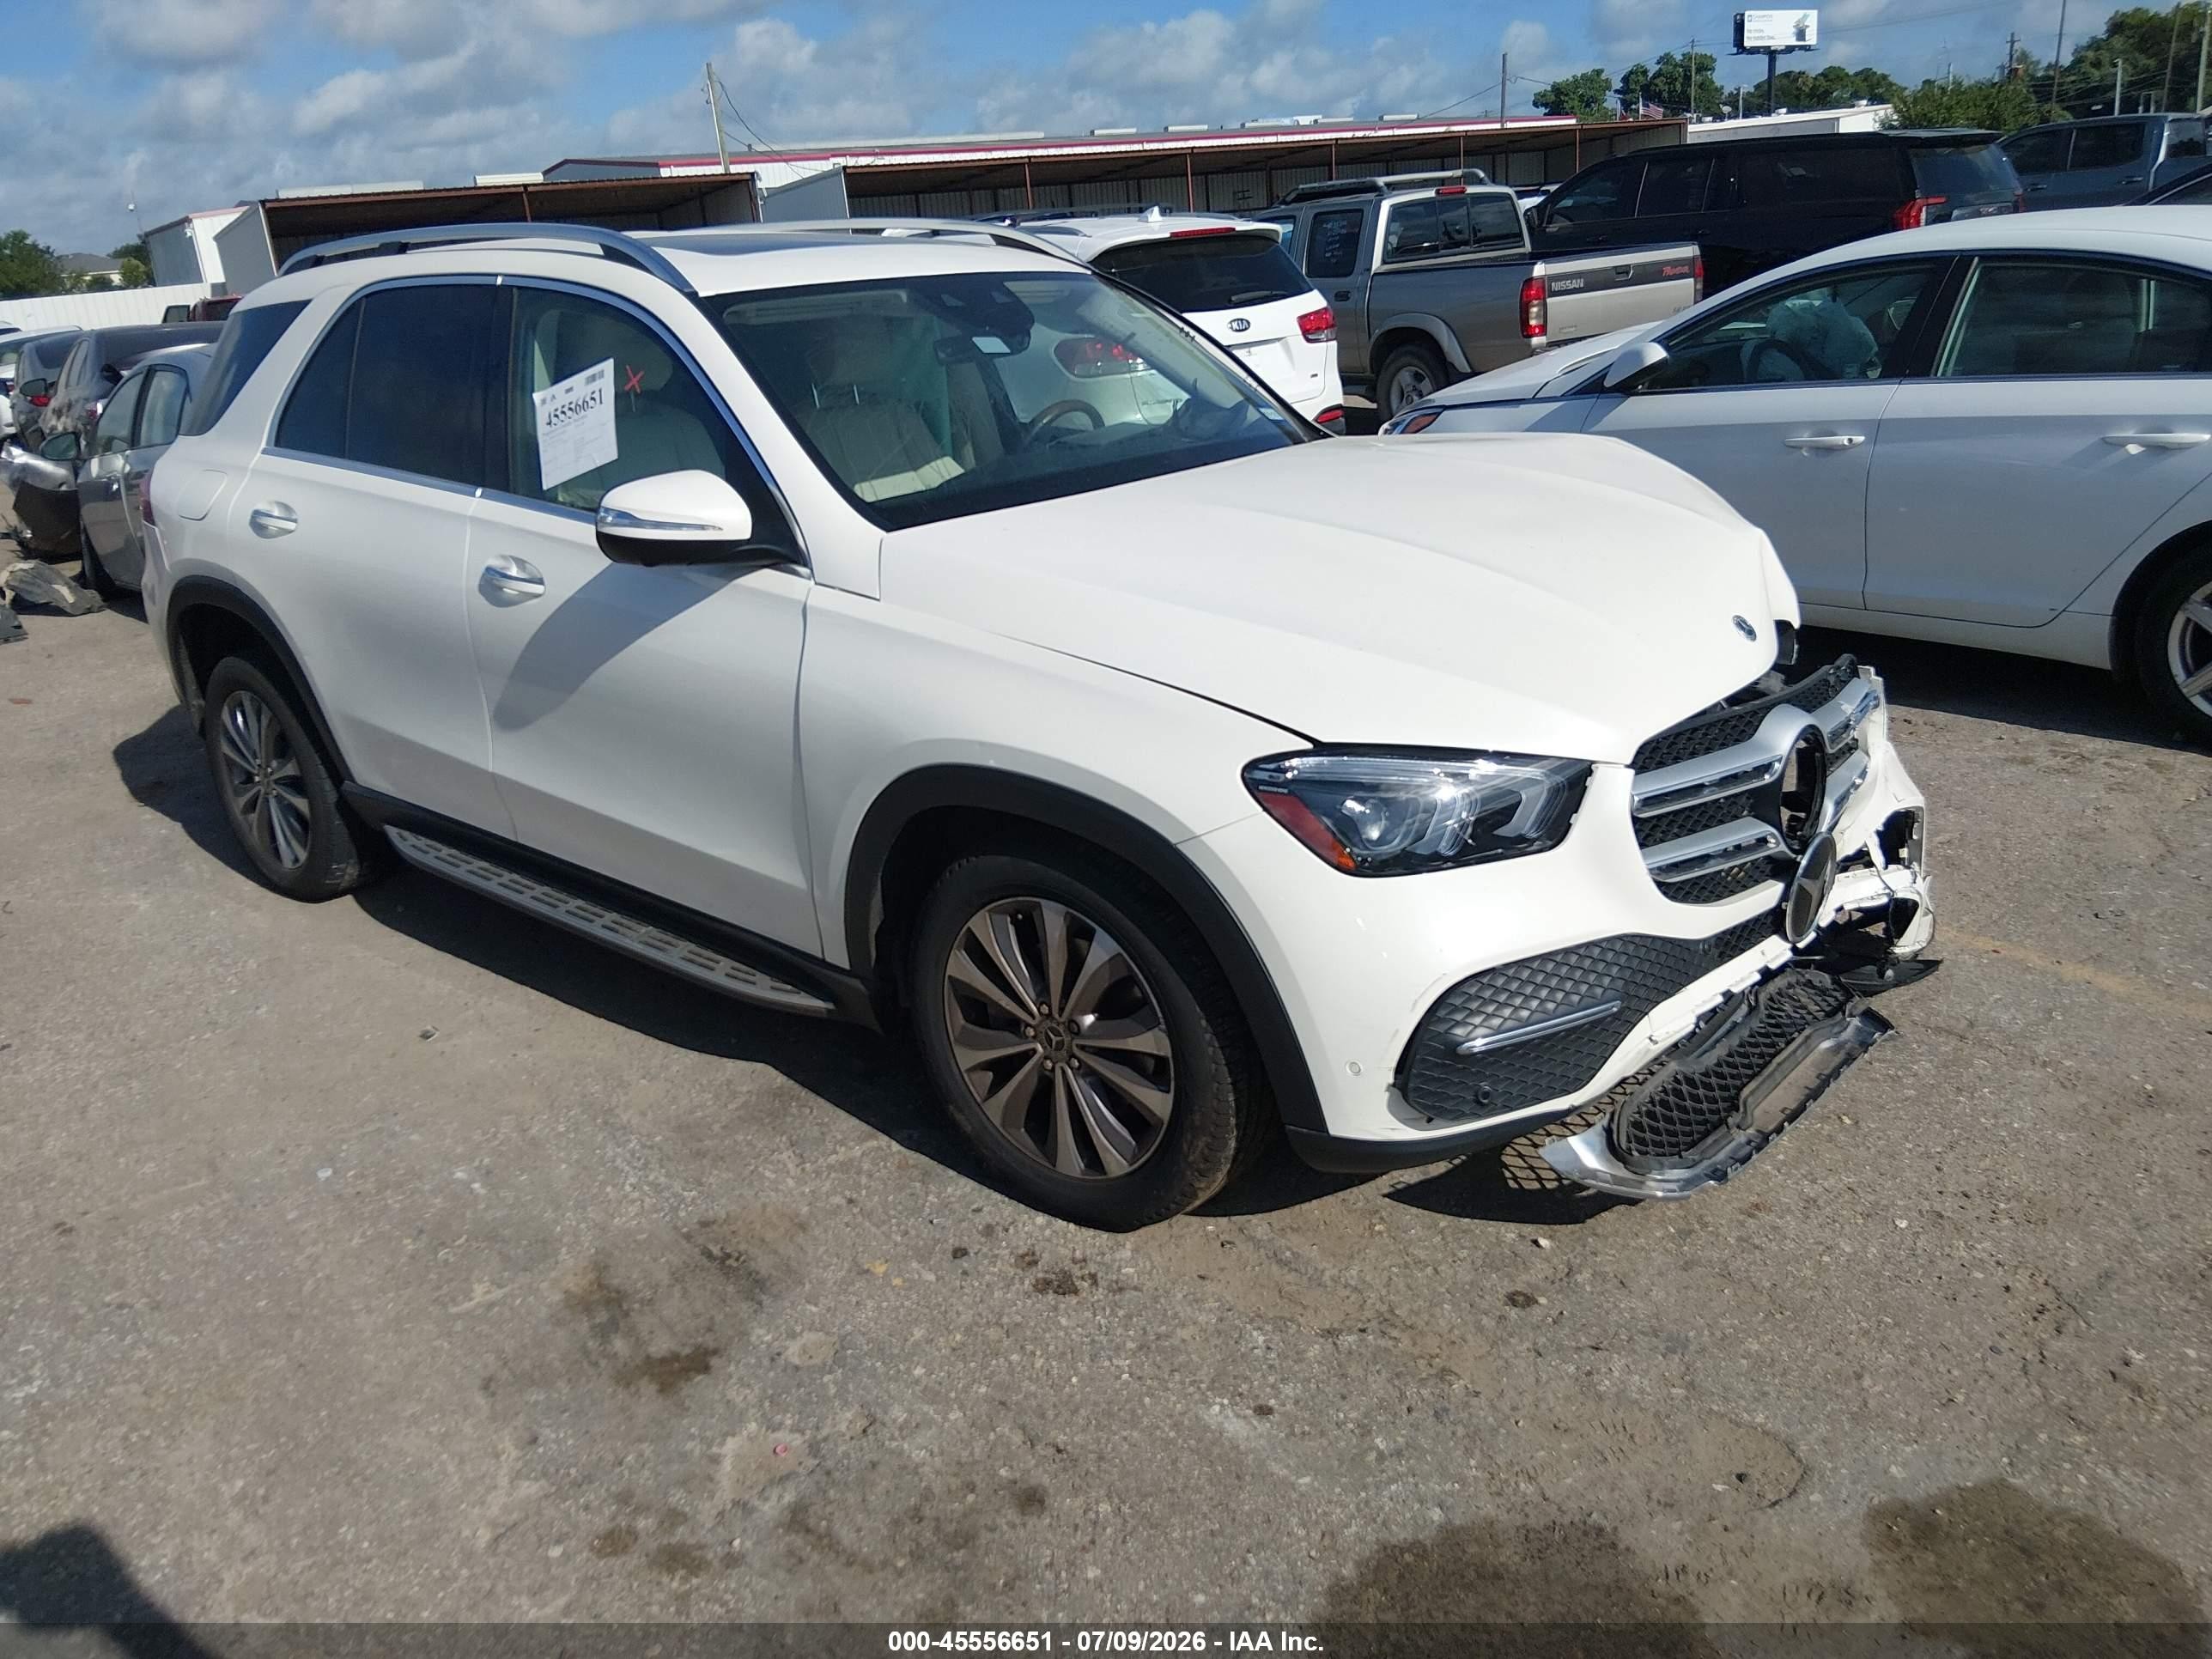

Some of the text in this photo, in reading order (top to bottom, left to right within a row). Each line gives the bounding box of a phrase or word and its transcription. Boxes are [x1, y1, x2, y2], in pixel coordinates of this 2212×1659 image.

[1551, 278, 1584, 292] NISSAN
[1231, 319, 1249, 331] KIA
[546, 388, 604, 428] 45556651
